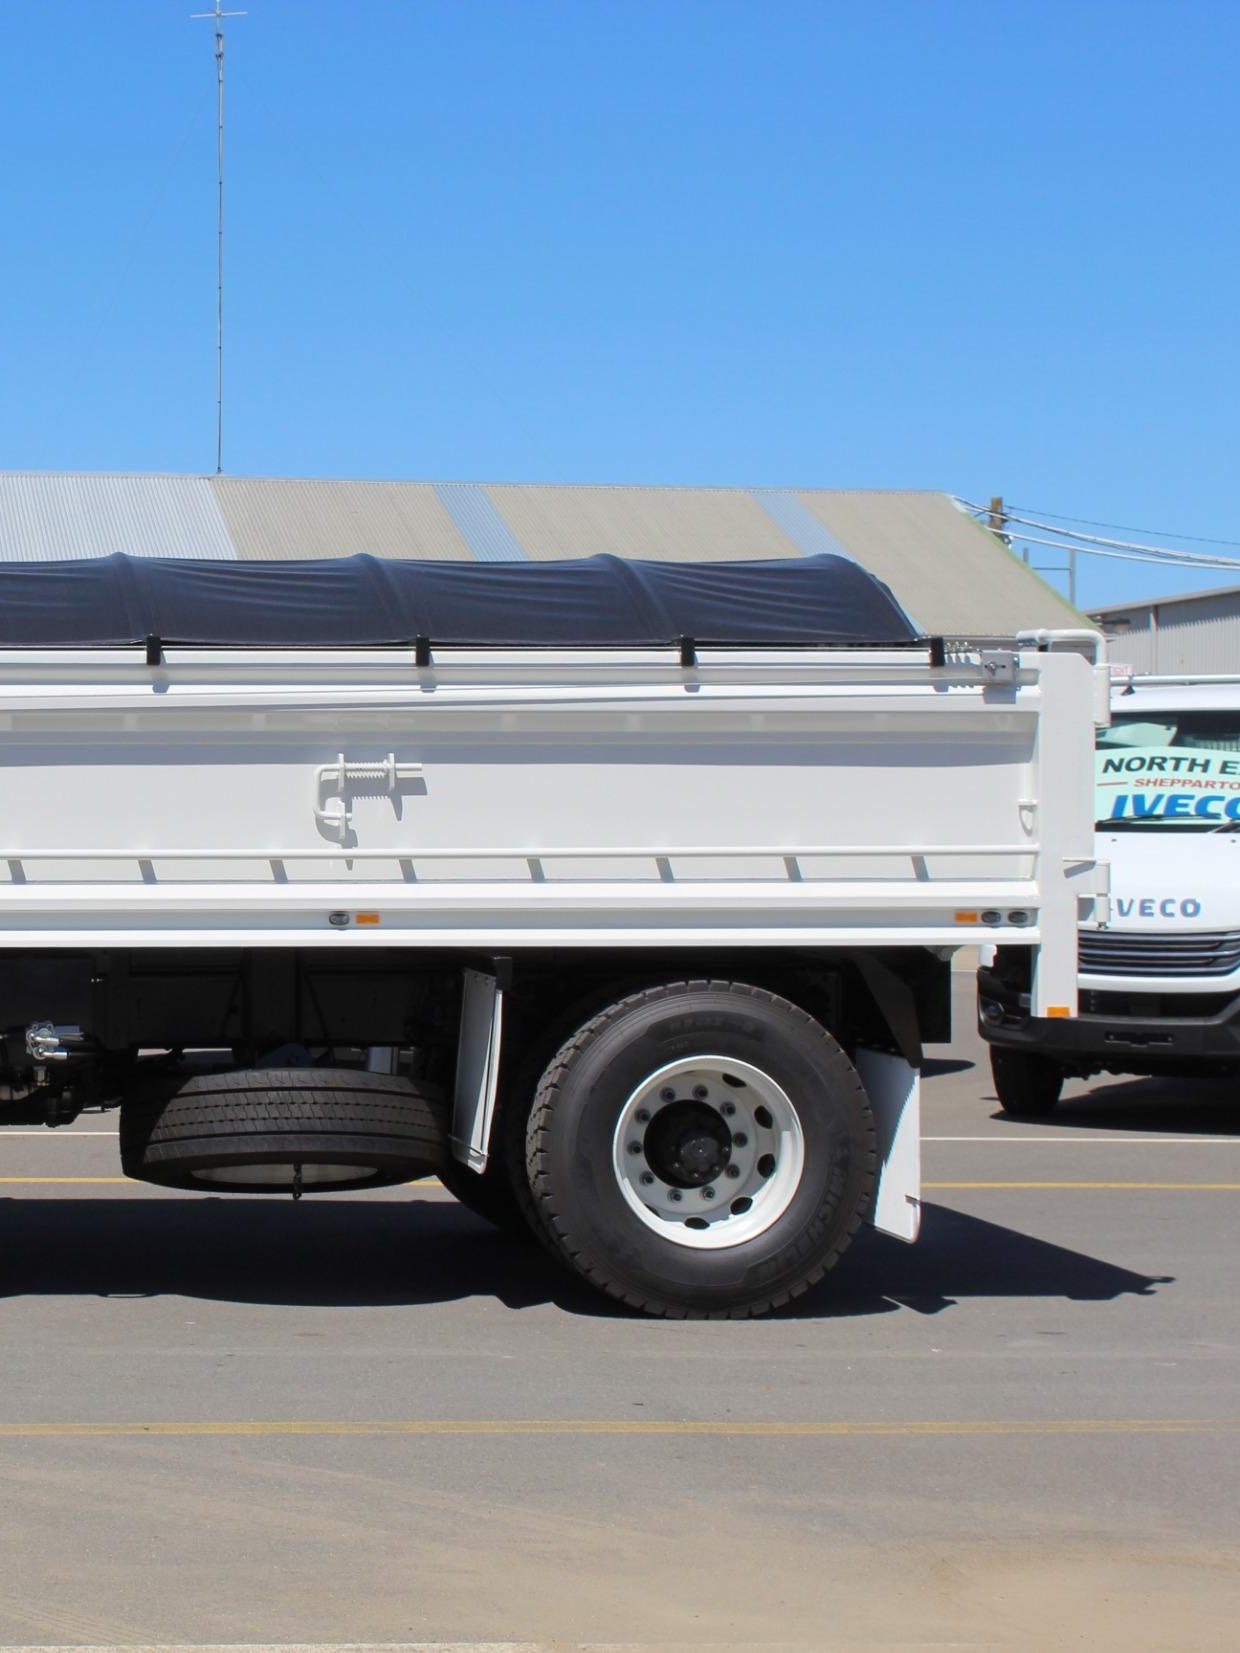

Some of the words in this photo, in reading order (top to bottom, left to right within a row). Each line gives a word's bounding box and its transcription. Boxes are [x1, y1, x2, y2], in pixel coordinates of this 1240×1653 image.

[1102, 755, 1211, 774] NORTH
[1219, 759, 1240, 775] E
[1133, 777, 1240, 790] SHEPPARTO
[1114, 897, 1202, 919] VECO
